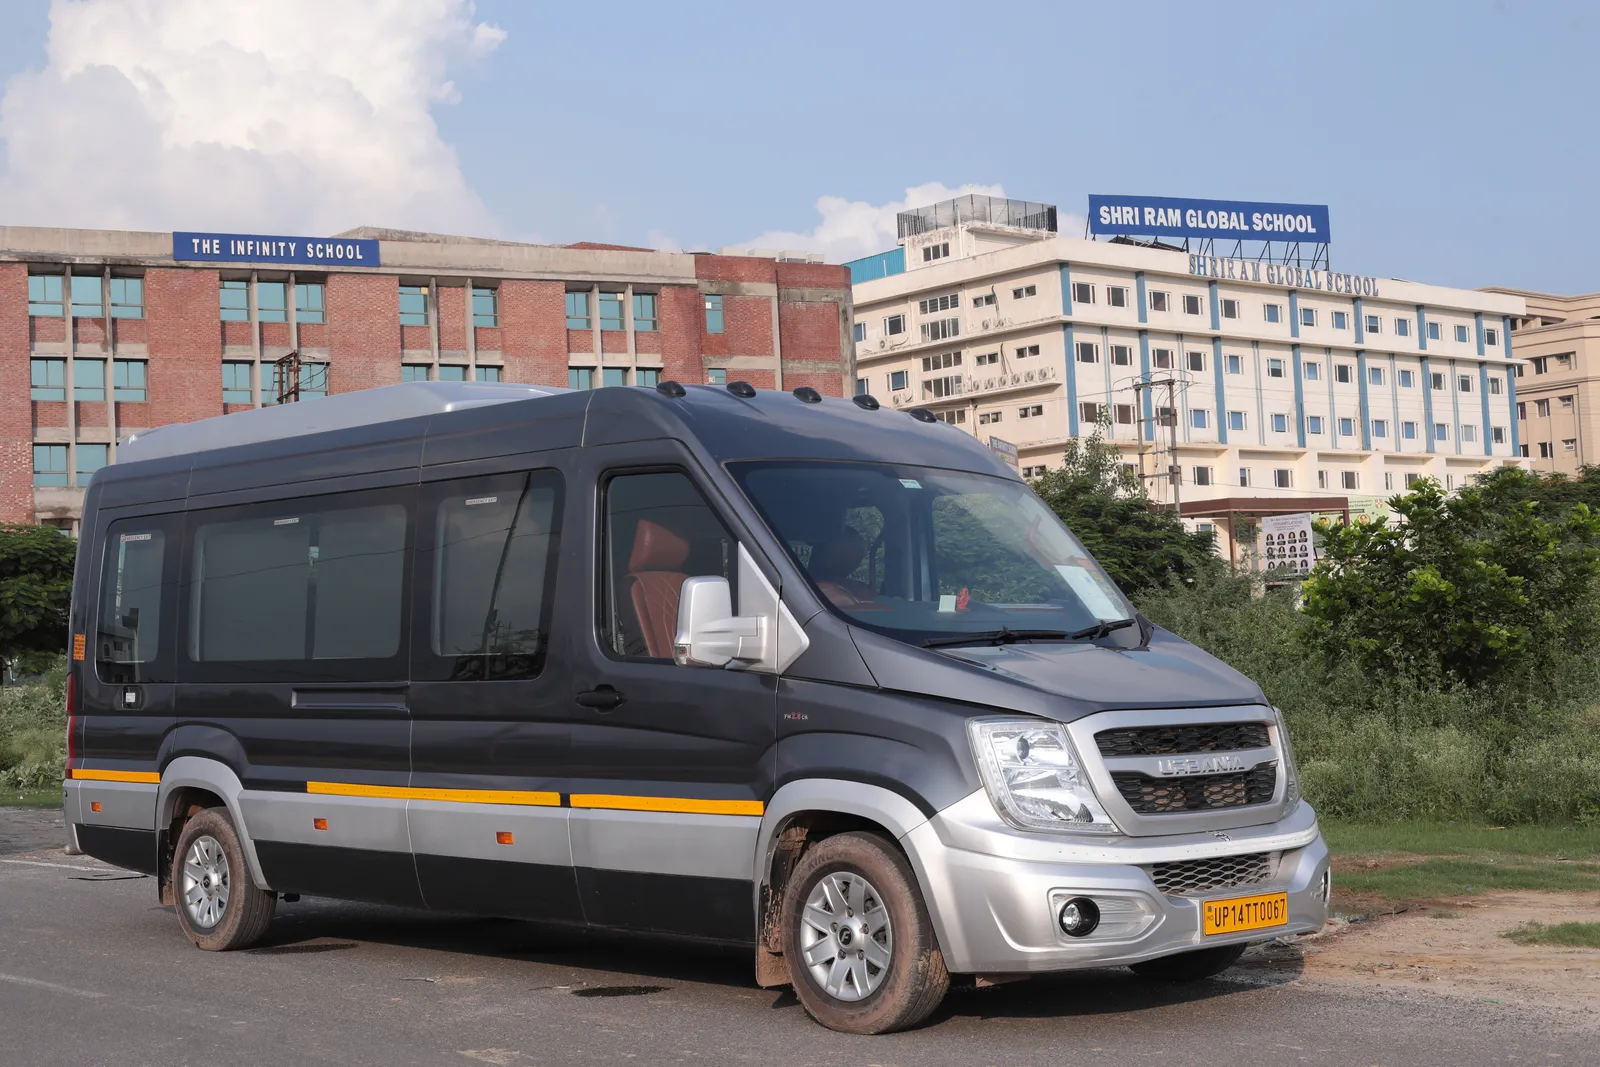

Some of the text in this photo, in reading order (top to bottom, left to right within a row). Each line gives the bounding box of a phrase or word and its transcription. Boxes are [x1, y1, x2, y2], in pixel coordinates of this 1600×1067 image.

[1100, 206, 1317, 233] SHRI RAM GLOBAL SCHOOL
[192, 238, 363, 260] THE INFINITY SCHOOL
[1267, 263, 1322, 290] GLOBAL
[1326, 271, 1379, 297] SCHOOL
[1158, 756, 1245, 775] URBANIA
[1214, 899, 1285, 927] UP14TT0067
